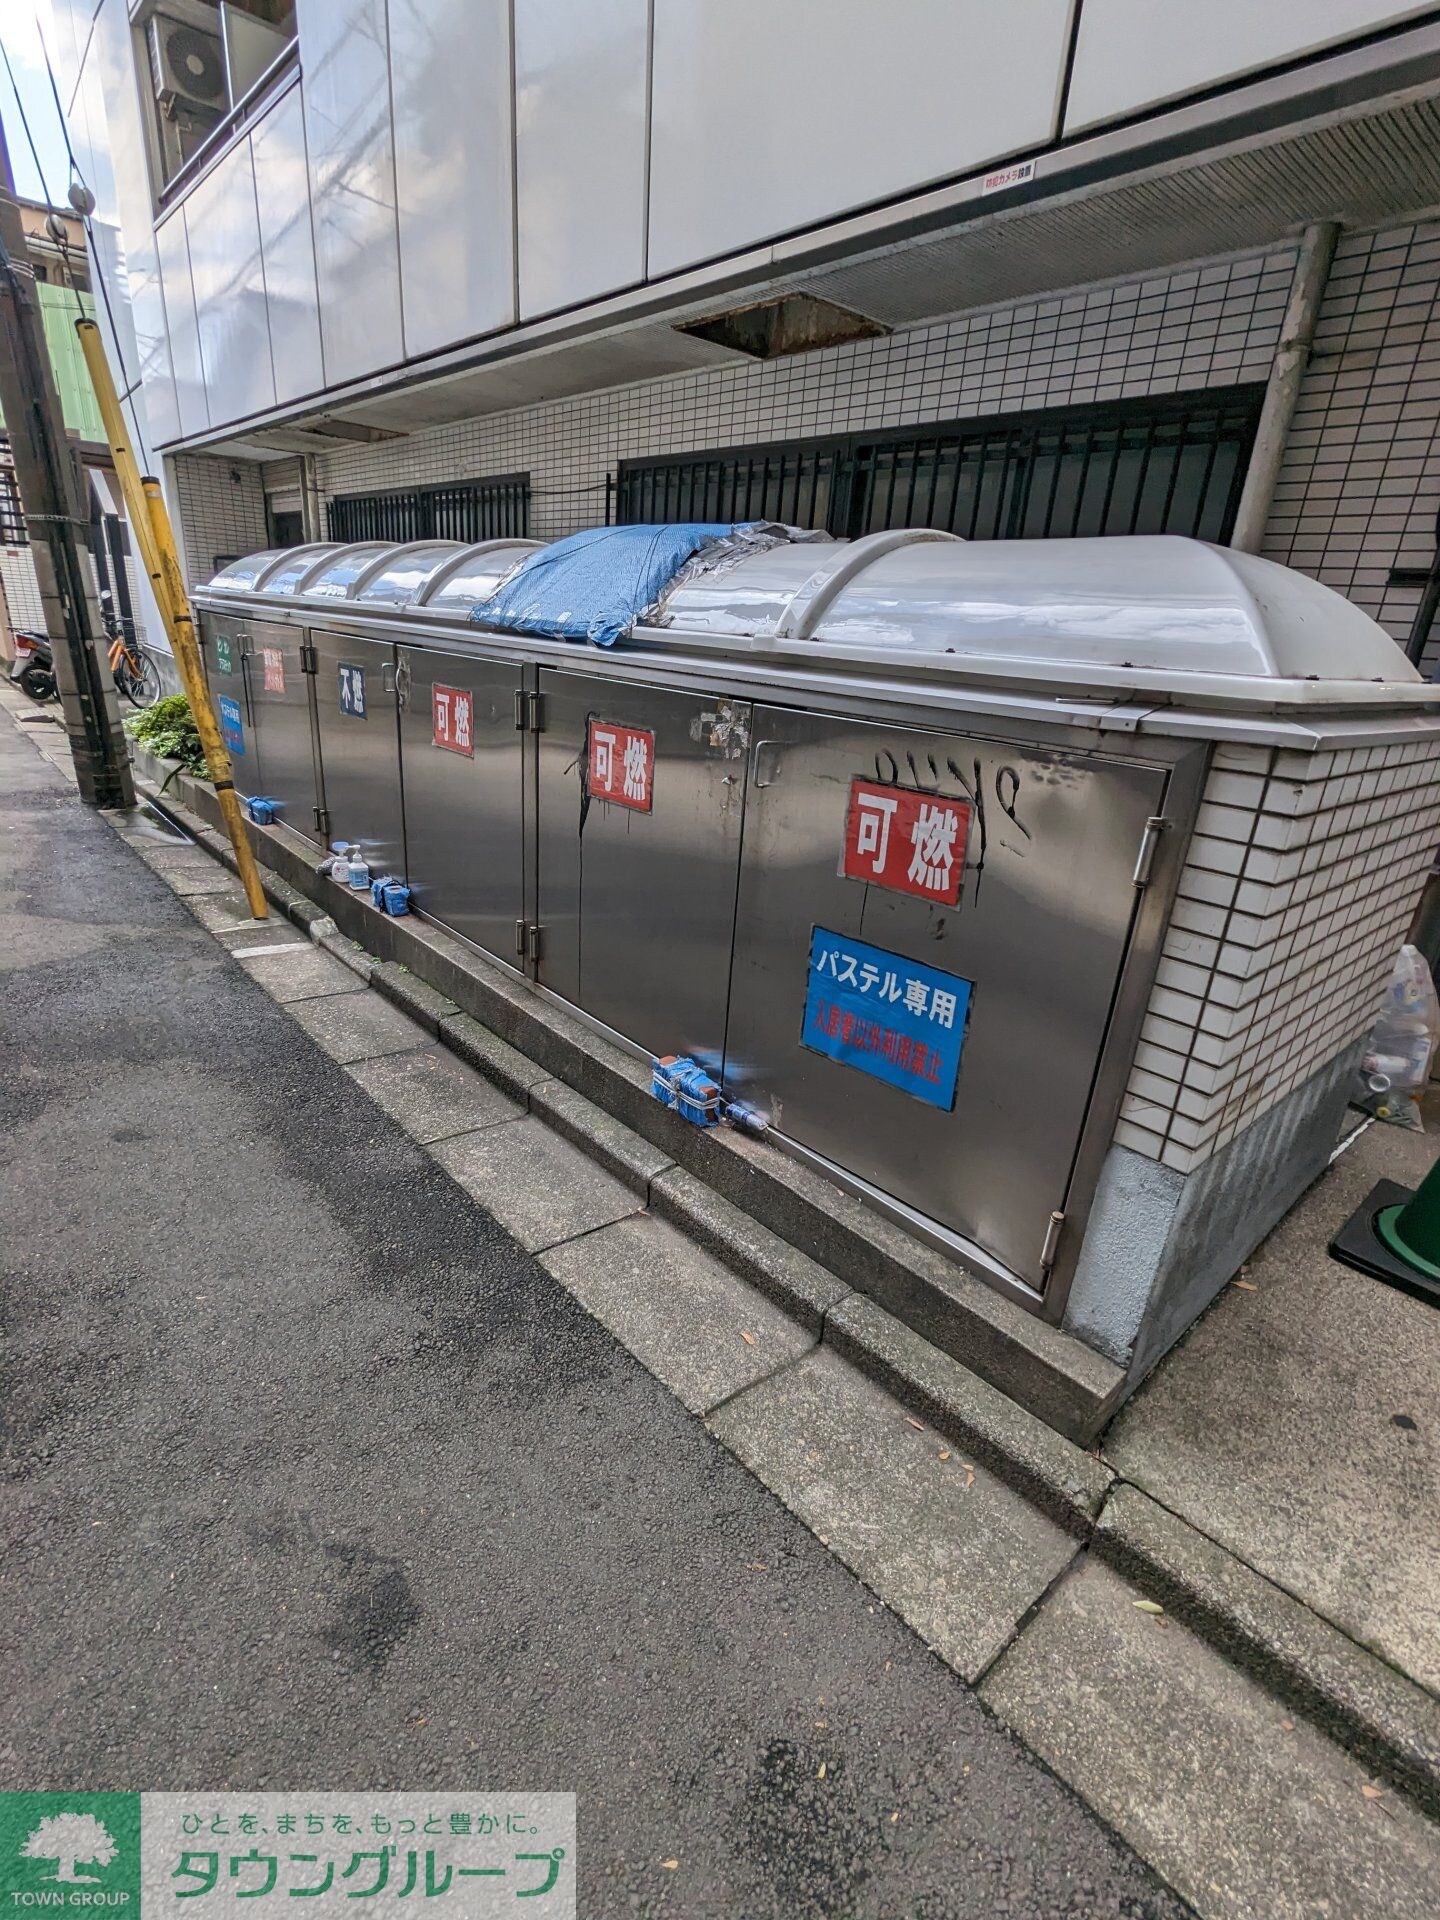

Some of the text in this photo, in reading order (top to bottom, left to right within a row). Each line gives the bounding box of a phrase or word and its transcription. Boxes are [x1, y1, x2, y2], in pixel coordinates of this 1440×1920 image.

[340, 668, 364, 713] 不燃
[436, 693, 470, 747] 可燃
[594, 731, 647, 801] 可燃
[857, 792, 958, 891] 可燃
[816, 950, 957, 1029] パステル専用
[813, 1000, 943, 1084] 入居者以外利用禁止
